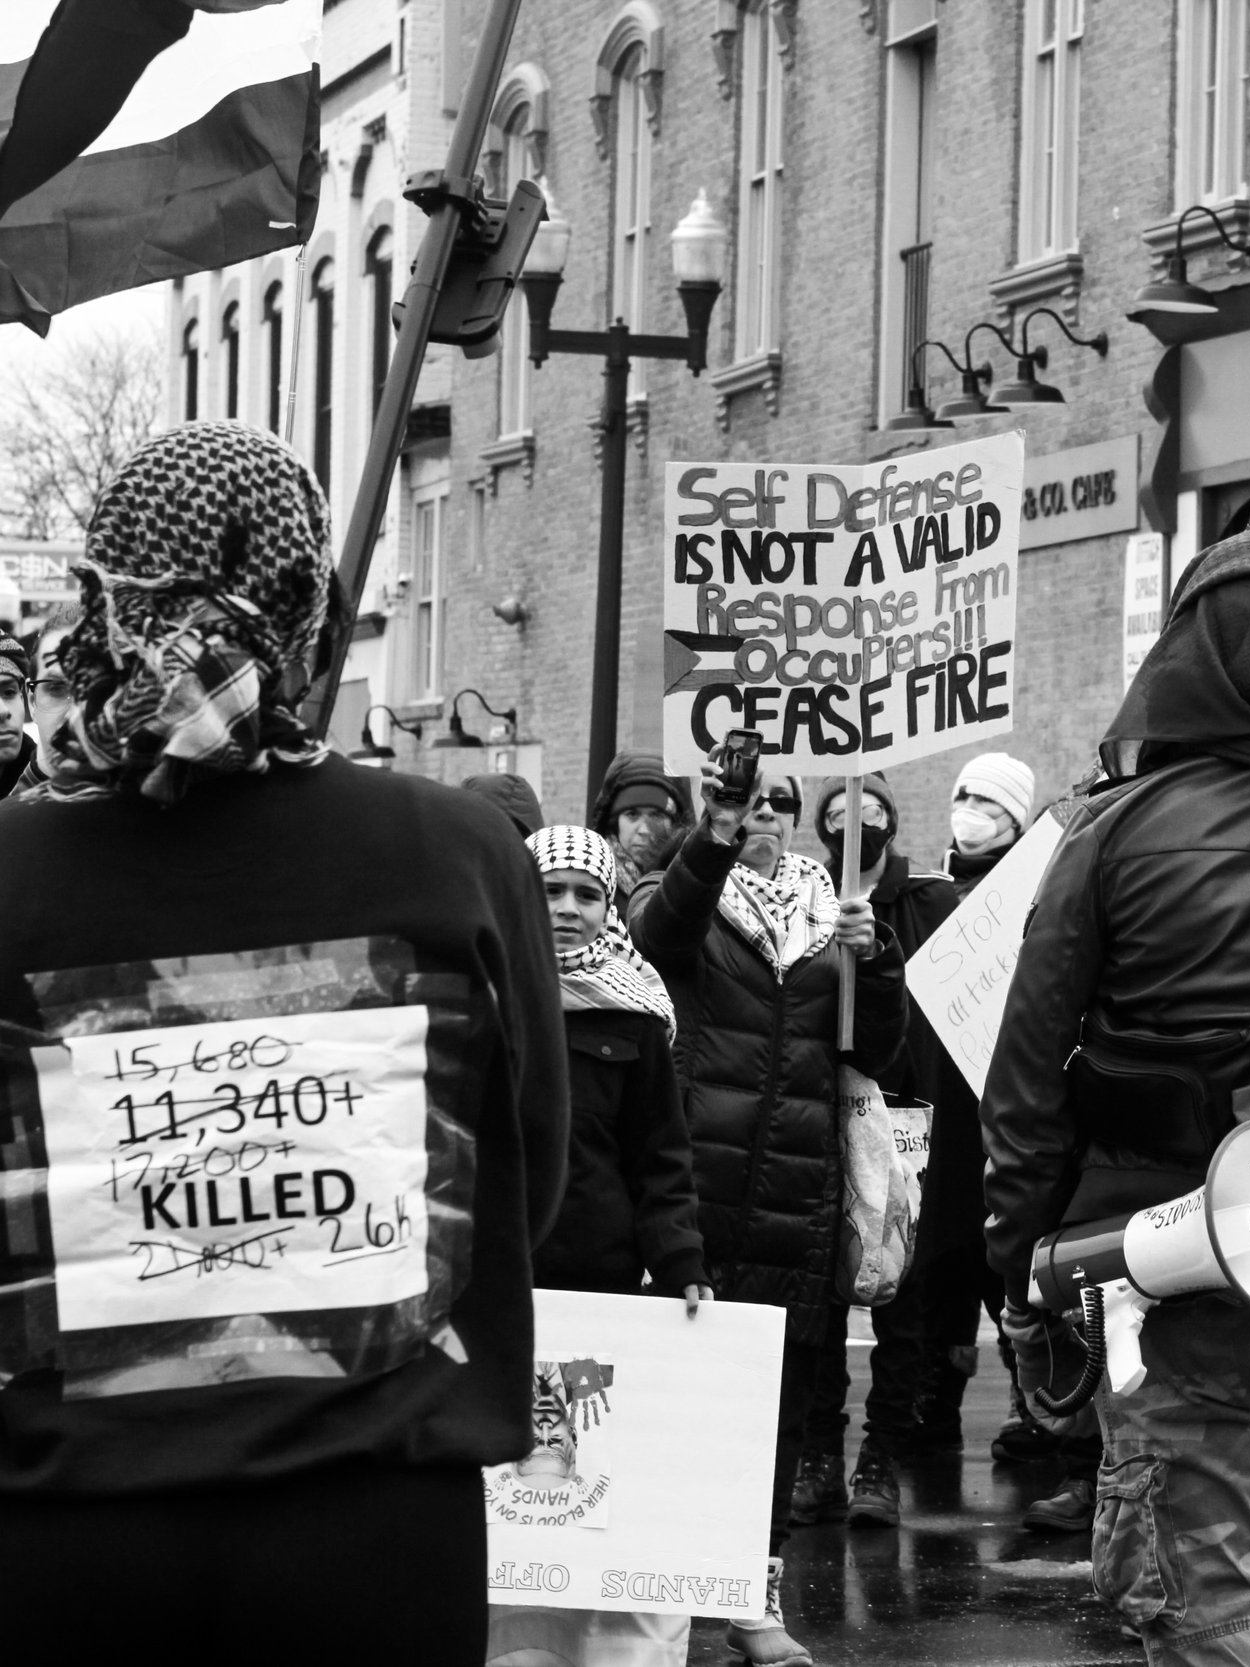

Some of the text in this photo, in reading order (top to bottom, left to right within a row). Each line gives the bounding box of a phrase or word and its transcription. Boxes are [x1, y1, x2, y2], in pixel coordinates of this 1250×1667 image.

[677, 462, 983, 533] Self Defense
[1071, 468, 1116, 511] CAFE
[674, 501, 1002, 587] IS NOT A VALID
[697, 561, 1011, 652] Response From
[691, 673, 893, 756] CEASE
[110, 1074, 364, 1147] 11,340+
[141, 1168, 356, 1230] KILLED
[495, 1503, 518, 1521] ON
[511, 1488, 570, 1506] HANDS
[582, 1474, 611, 1509] THEIR
[488, 1561, 751, 1608] HANDS OFF
